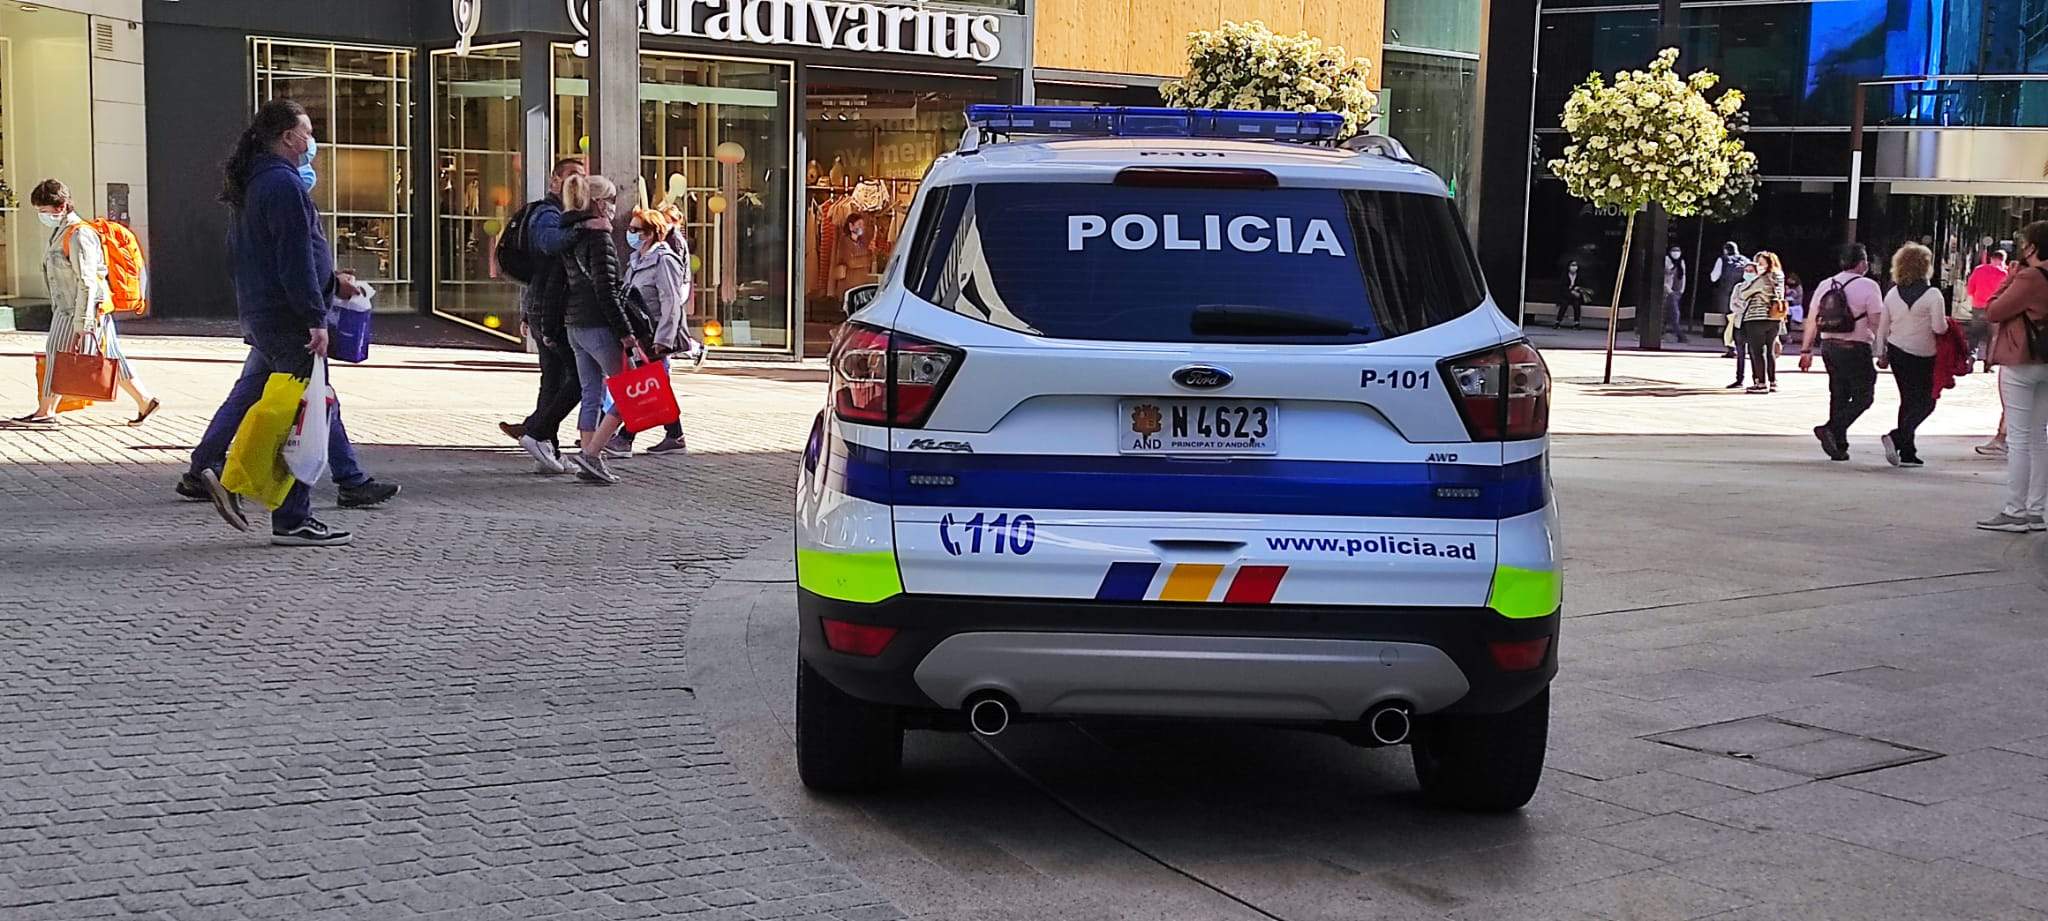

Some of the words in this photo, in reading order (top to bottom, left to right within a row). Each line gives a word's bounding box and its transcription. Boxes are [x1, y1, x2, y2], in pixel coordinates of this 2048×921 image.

[636, 0, 1000, 62] tradivarius
[1067, 213, 1347, 257] POLICIA
[1185, 370, 1219, 385] Ford
[1359, 369, 1431, 390] P-101
[1172, 406, 1188, 438] N
[1198, 406, 1268, 438] 4623
[1133, 439, 1162, 450] AND
[1425, 453, 1458, 463] AWD
[964, 512, 1036, 556] 110
[1266, 536, 1477, 561] www.policia.ad
